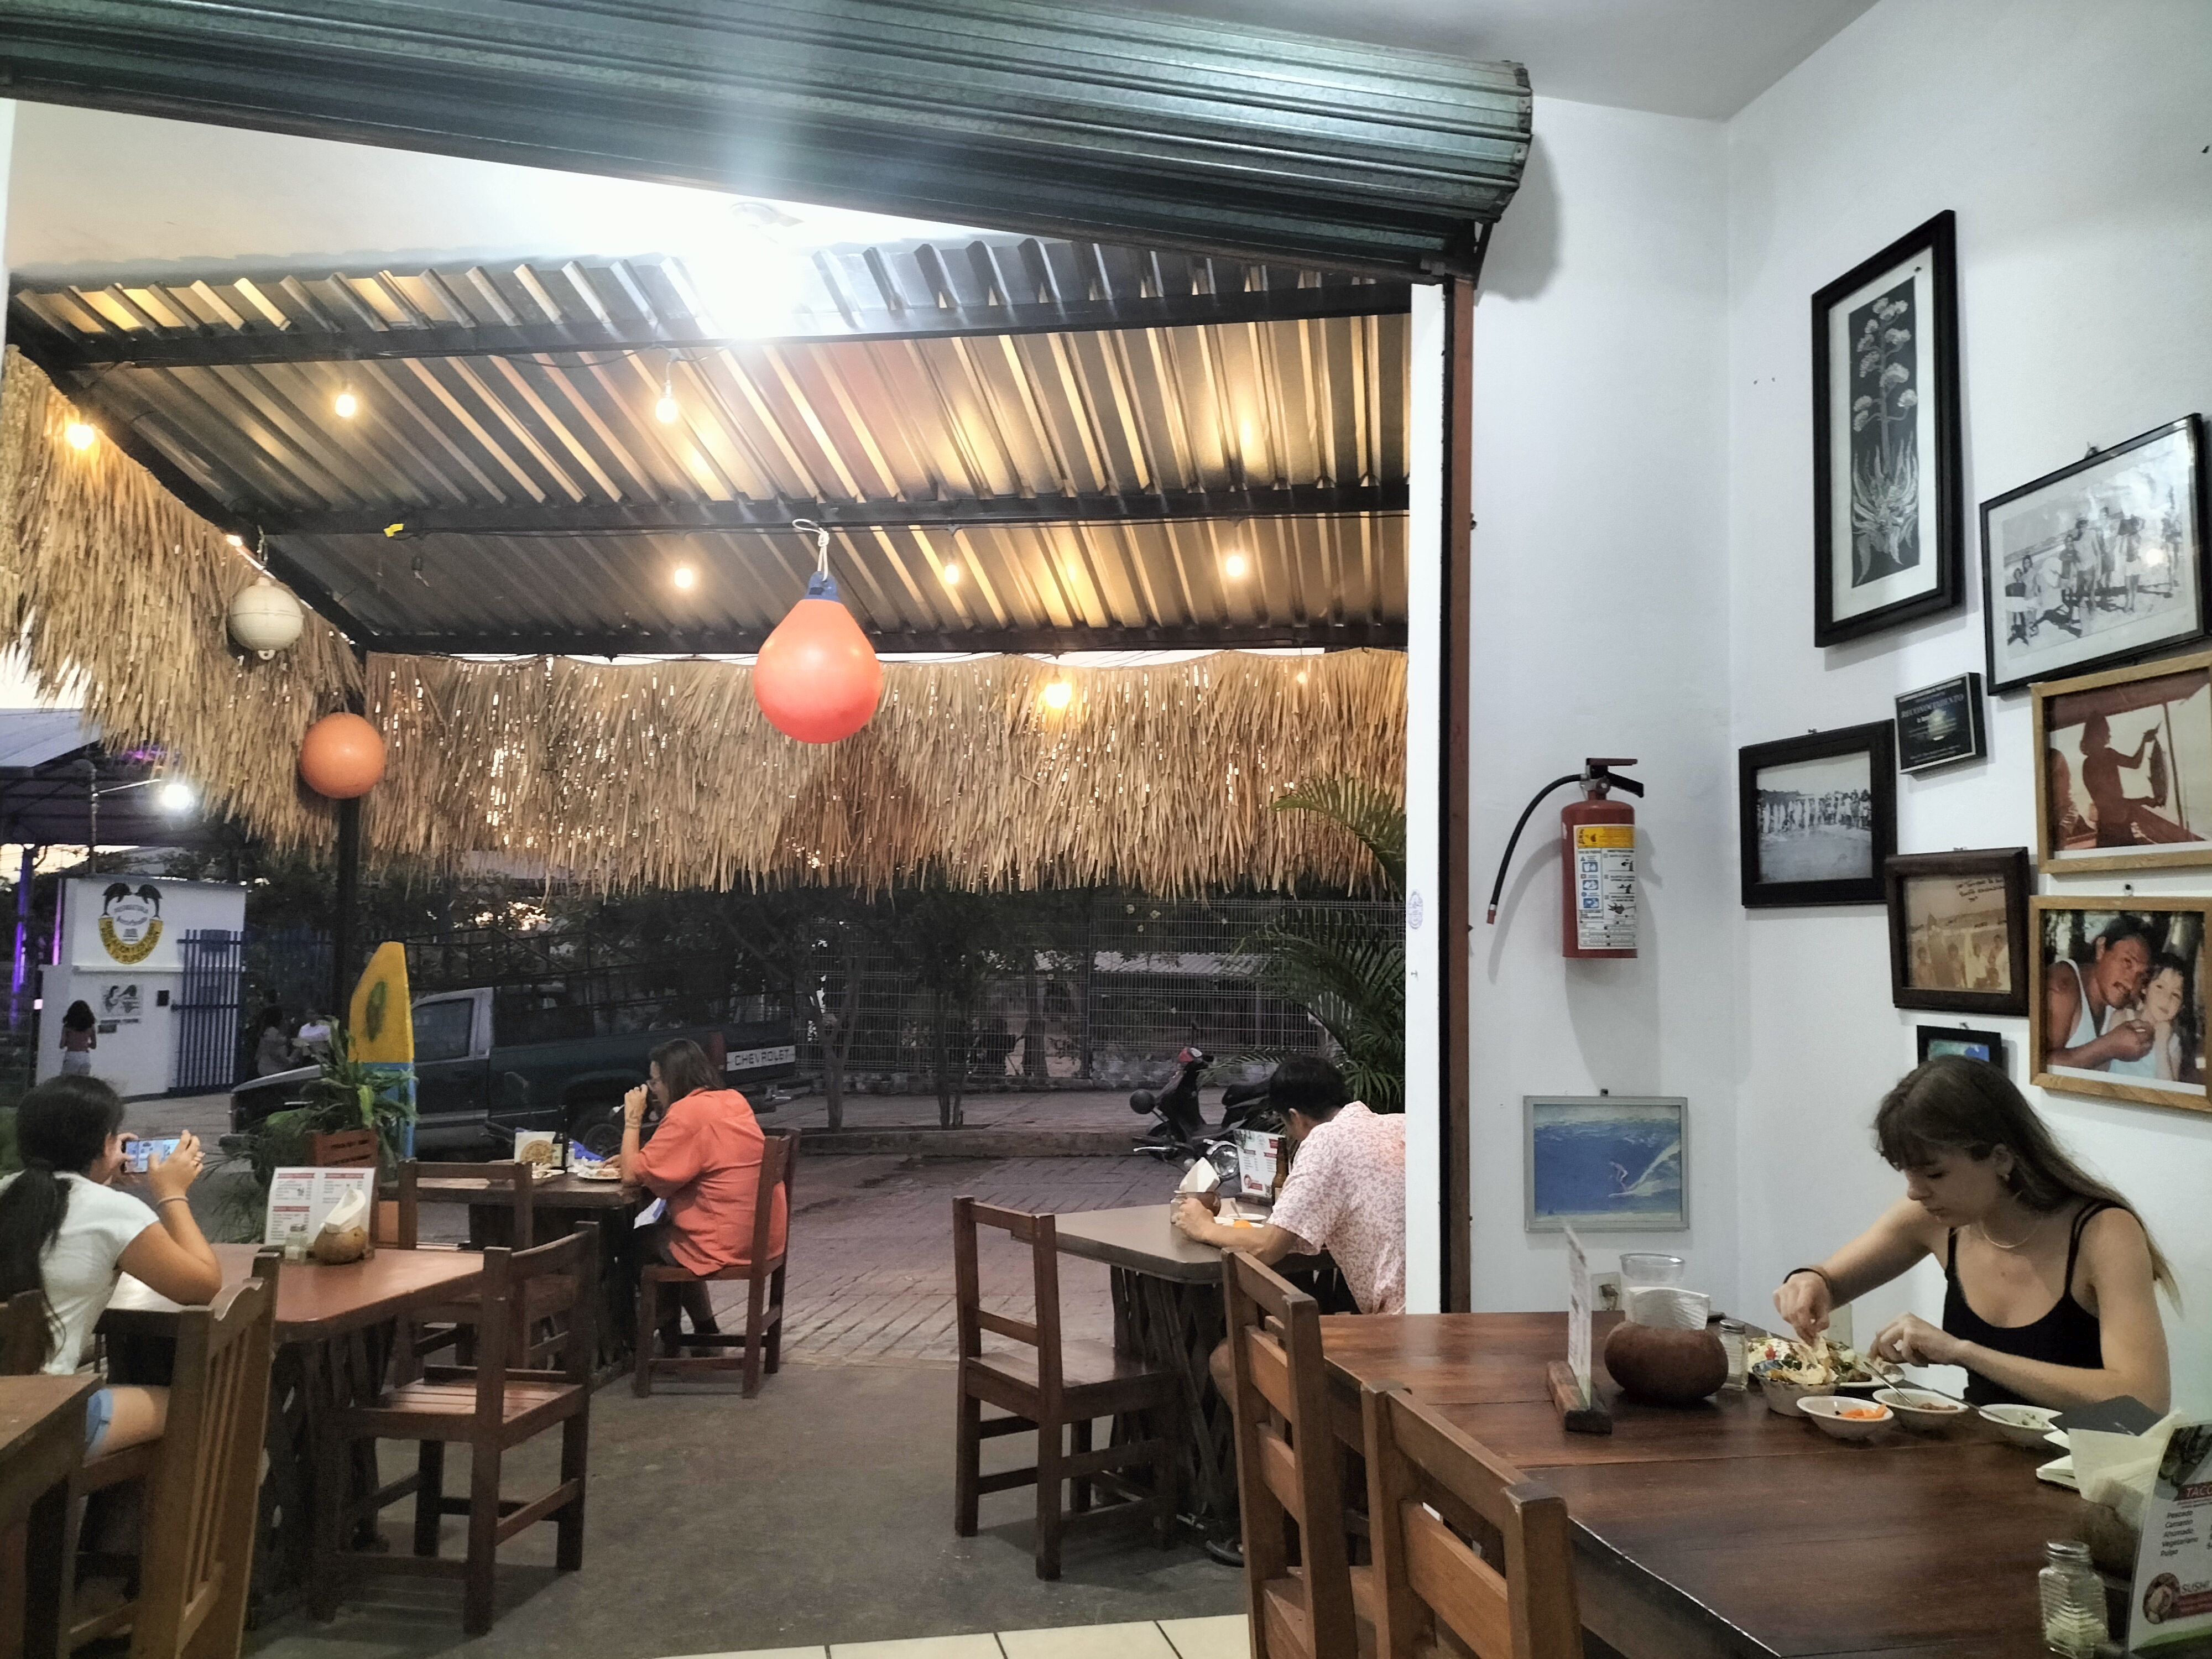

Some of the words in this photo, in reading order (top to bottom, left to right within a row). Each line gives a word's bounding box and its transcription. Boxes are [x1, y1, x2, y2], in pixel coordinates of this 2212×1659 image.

[734, 1049, 789, 1066] CHEVROLET
[2167, 1510, 2193, 1519] Pescado
[2163, 1528, 2194, 1538] Ahumado
